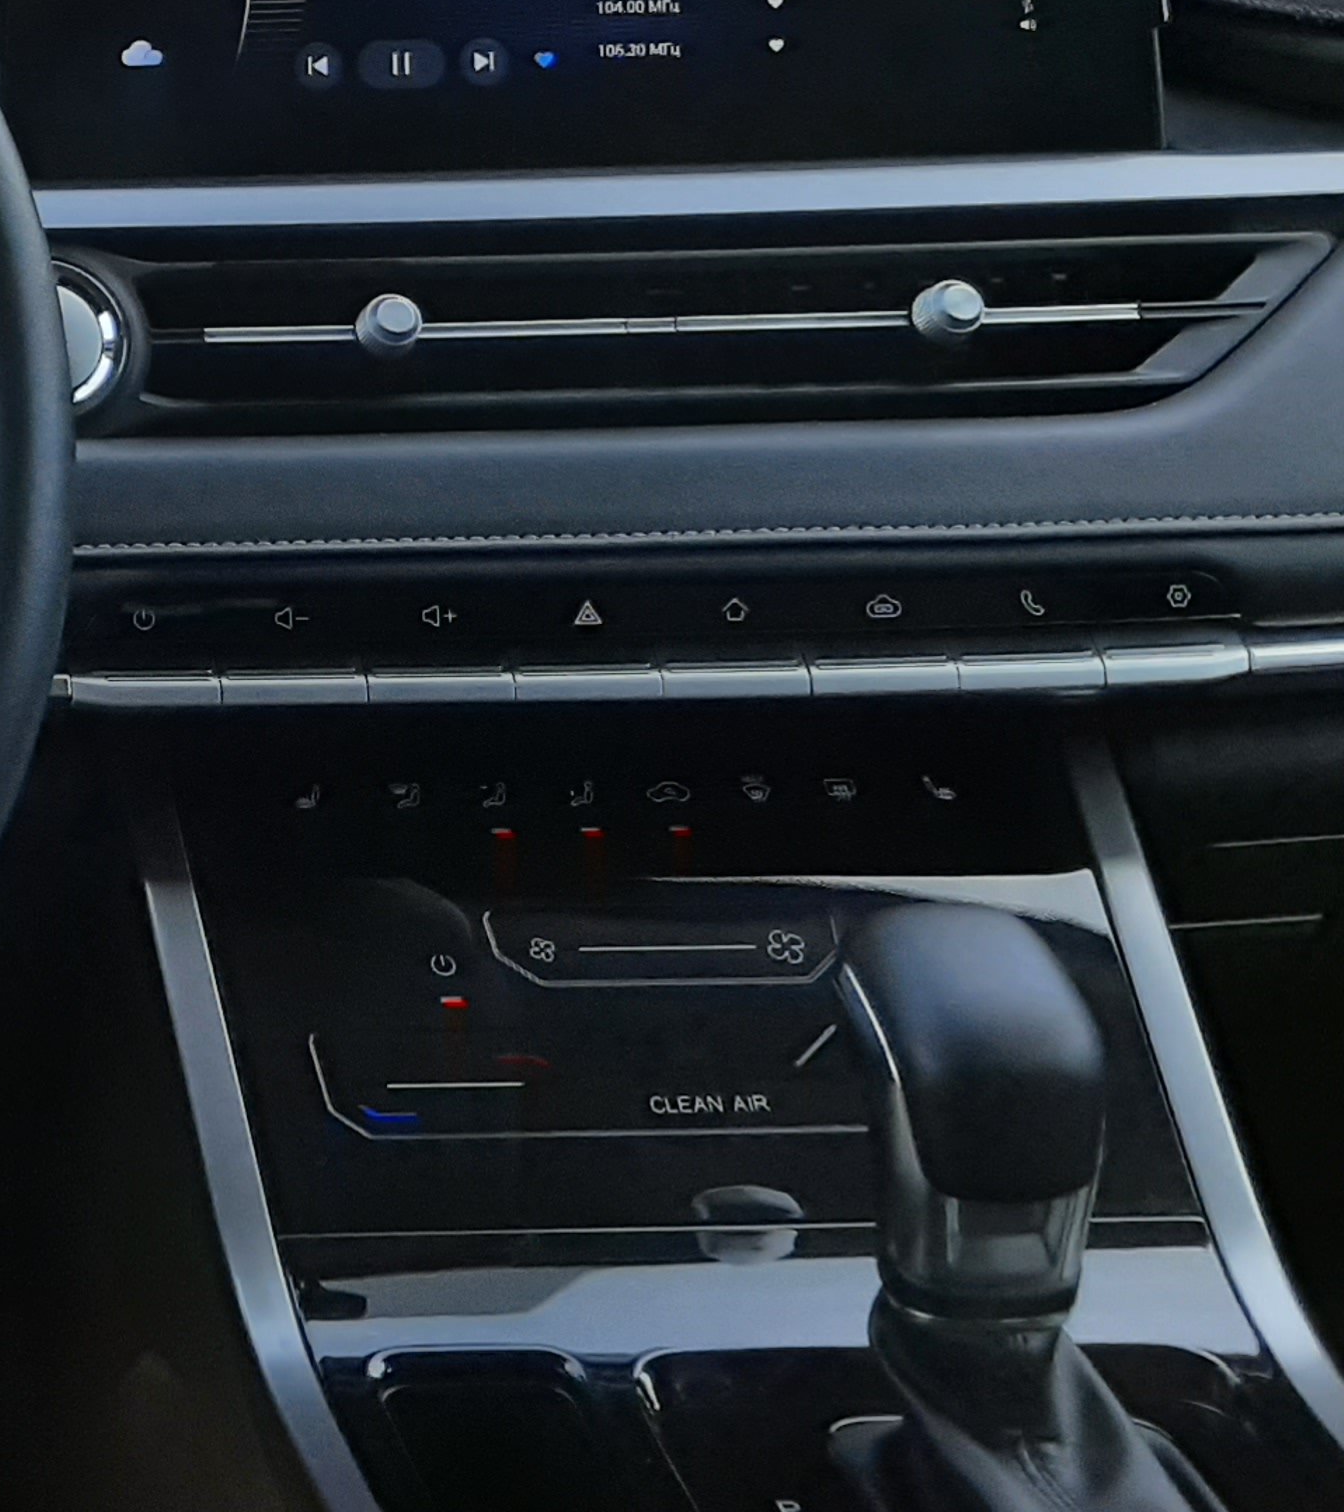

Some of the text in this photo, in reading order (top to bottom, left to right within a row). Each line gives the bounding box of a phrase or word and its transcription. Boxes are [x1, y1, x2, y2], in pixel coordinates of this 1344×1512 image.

[648, 0, 680, 14] МГц
[649, 43, 681, 58] МГц
[649, 1093, 771, 1115] CLEAN AIR
